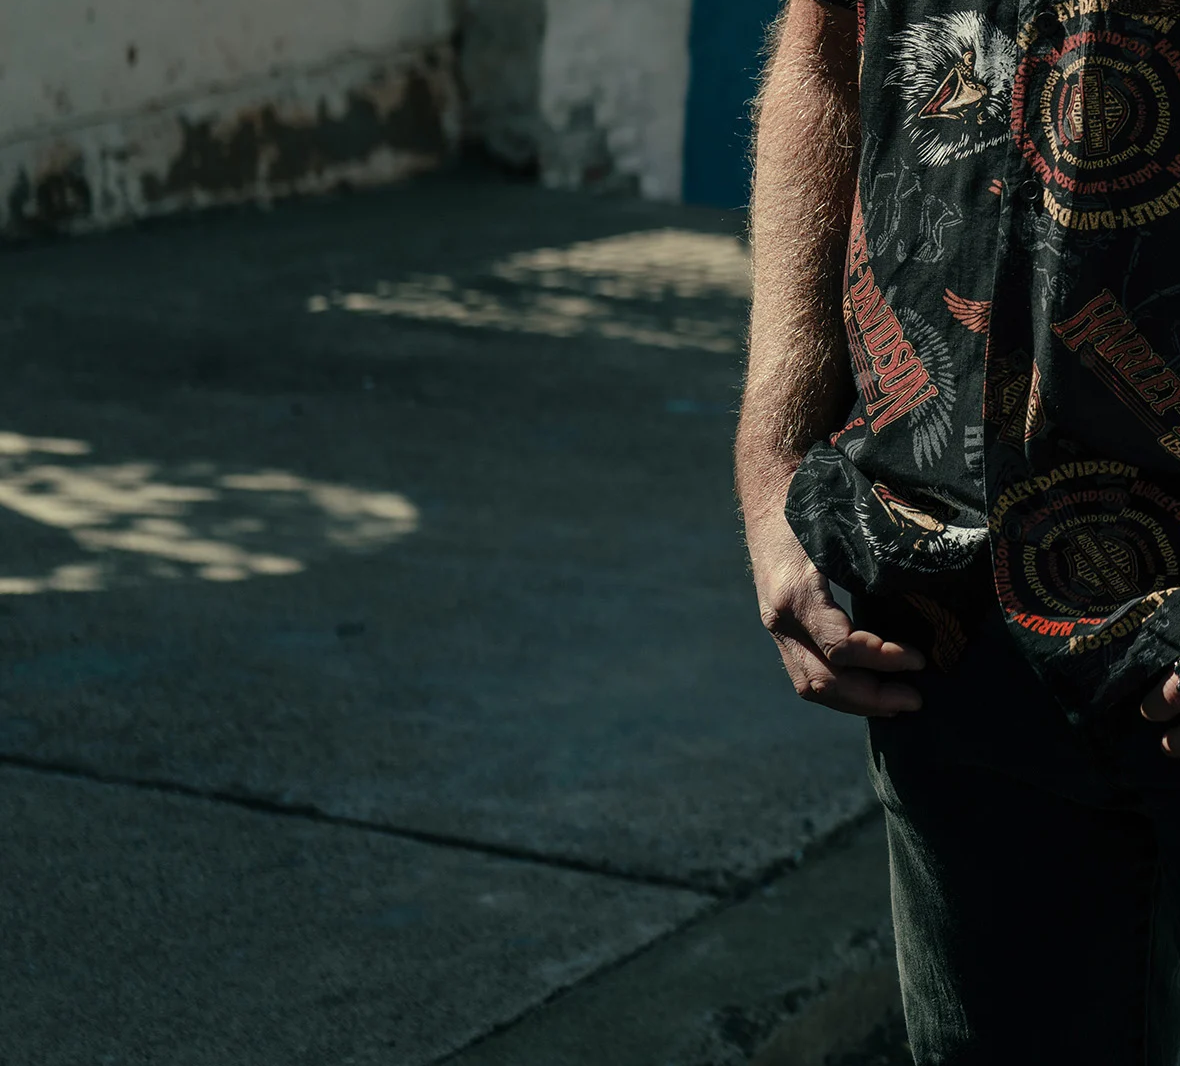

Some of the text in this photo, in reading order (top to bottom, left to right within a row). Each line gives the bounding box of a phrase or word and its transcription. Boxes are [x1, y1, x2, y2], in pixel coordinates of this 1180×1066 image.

[1134, 59, 1172, 157] HARLEY-DAVIDSON
[988, 460, 1140, 533] HARLEY-DAVIDSON
[1076, 533, 1133, 596] HARLEY-DAVIDSON
[1119, 507, 1179, 577] HARLEY-DAVIDSON
